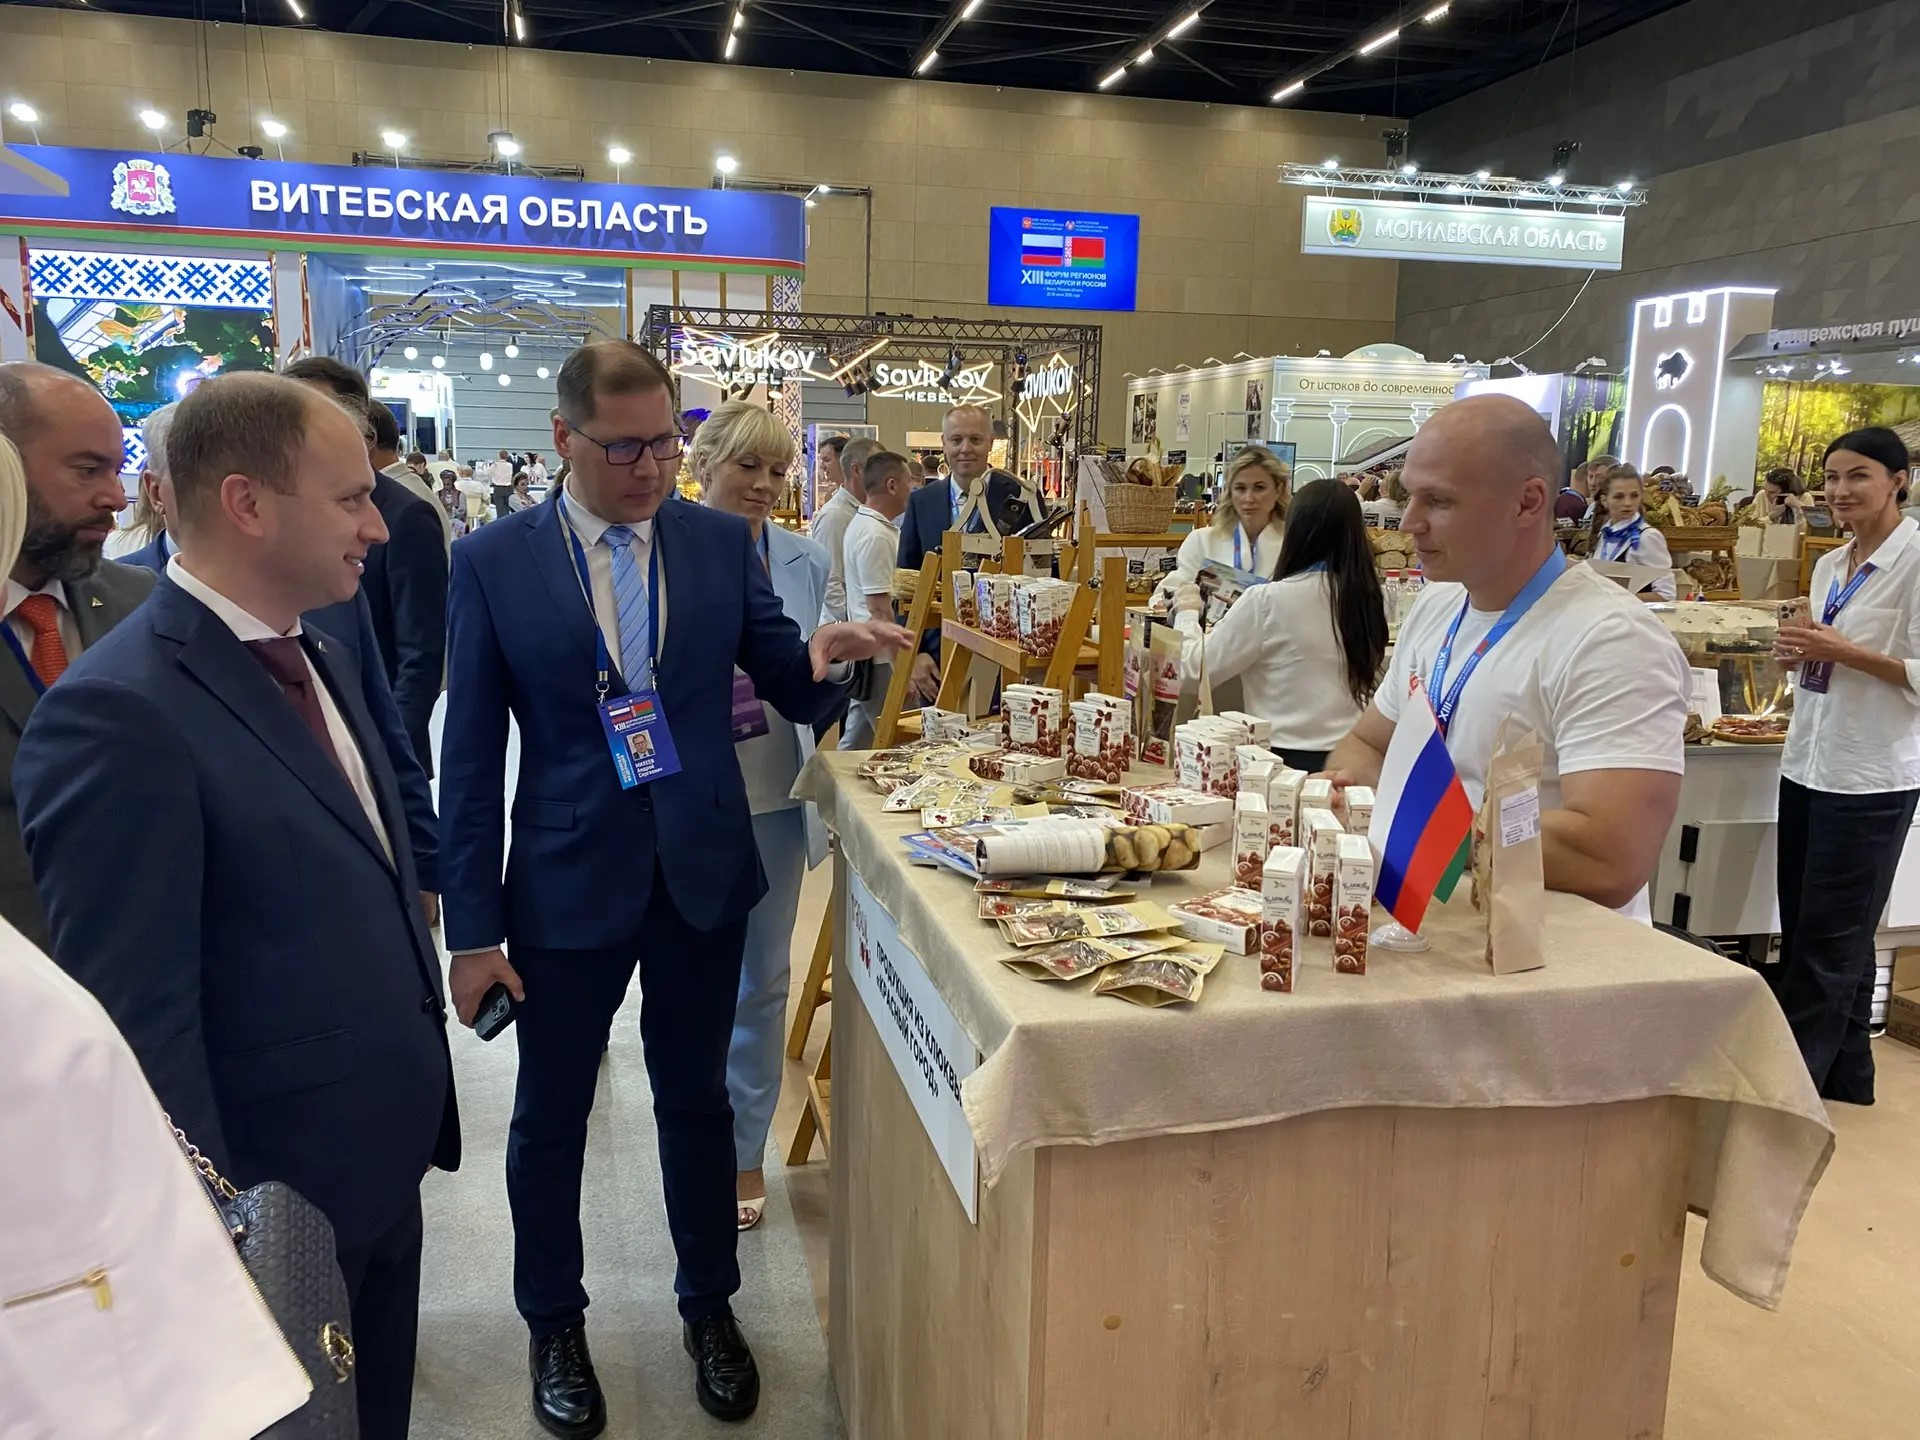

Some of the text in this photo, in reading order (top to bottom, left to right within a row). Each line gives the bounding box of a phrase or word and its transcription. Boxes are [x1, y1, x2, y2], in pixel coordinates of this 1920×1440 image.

[250, 180, 709, 236] ВИТЕБСКАЯ ОБЛАСТЬ
[1375, 218, 1608, 251] МОГИЛЕВСКАЯ ОБЛАСТЬ
[1021, 269, 1044, 285] XIII
[1044, 271, 1107, 280] ФОРУМ РЕГИОНОВ
[681, 340, 815, 371] Savlukov
[716, 370, 781, 384] MEBEL
[876, 363, 988, 388] Savluov
[1019, 364, 1074, 401] avlukov
[1299, 378, 1316, 390] От
[1317, 381, 1360, 392] истоков
[1363, 380, 1378, 392] до
[904, 390, 958, 403] MEBEL
[1437, 701, 1453, 722] XIII
[876, 940, 962, 1108] ПРОДУКЦИЯ ИЗ КЛЮКВЫ
[876, 974, 939, 1098] «КРАСНЫЙ ГОРОД»
